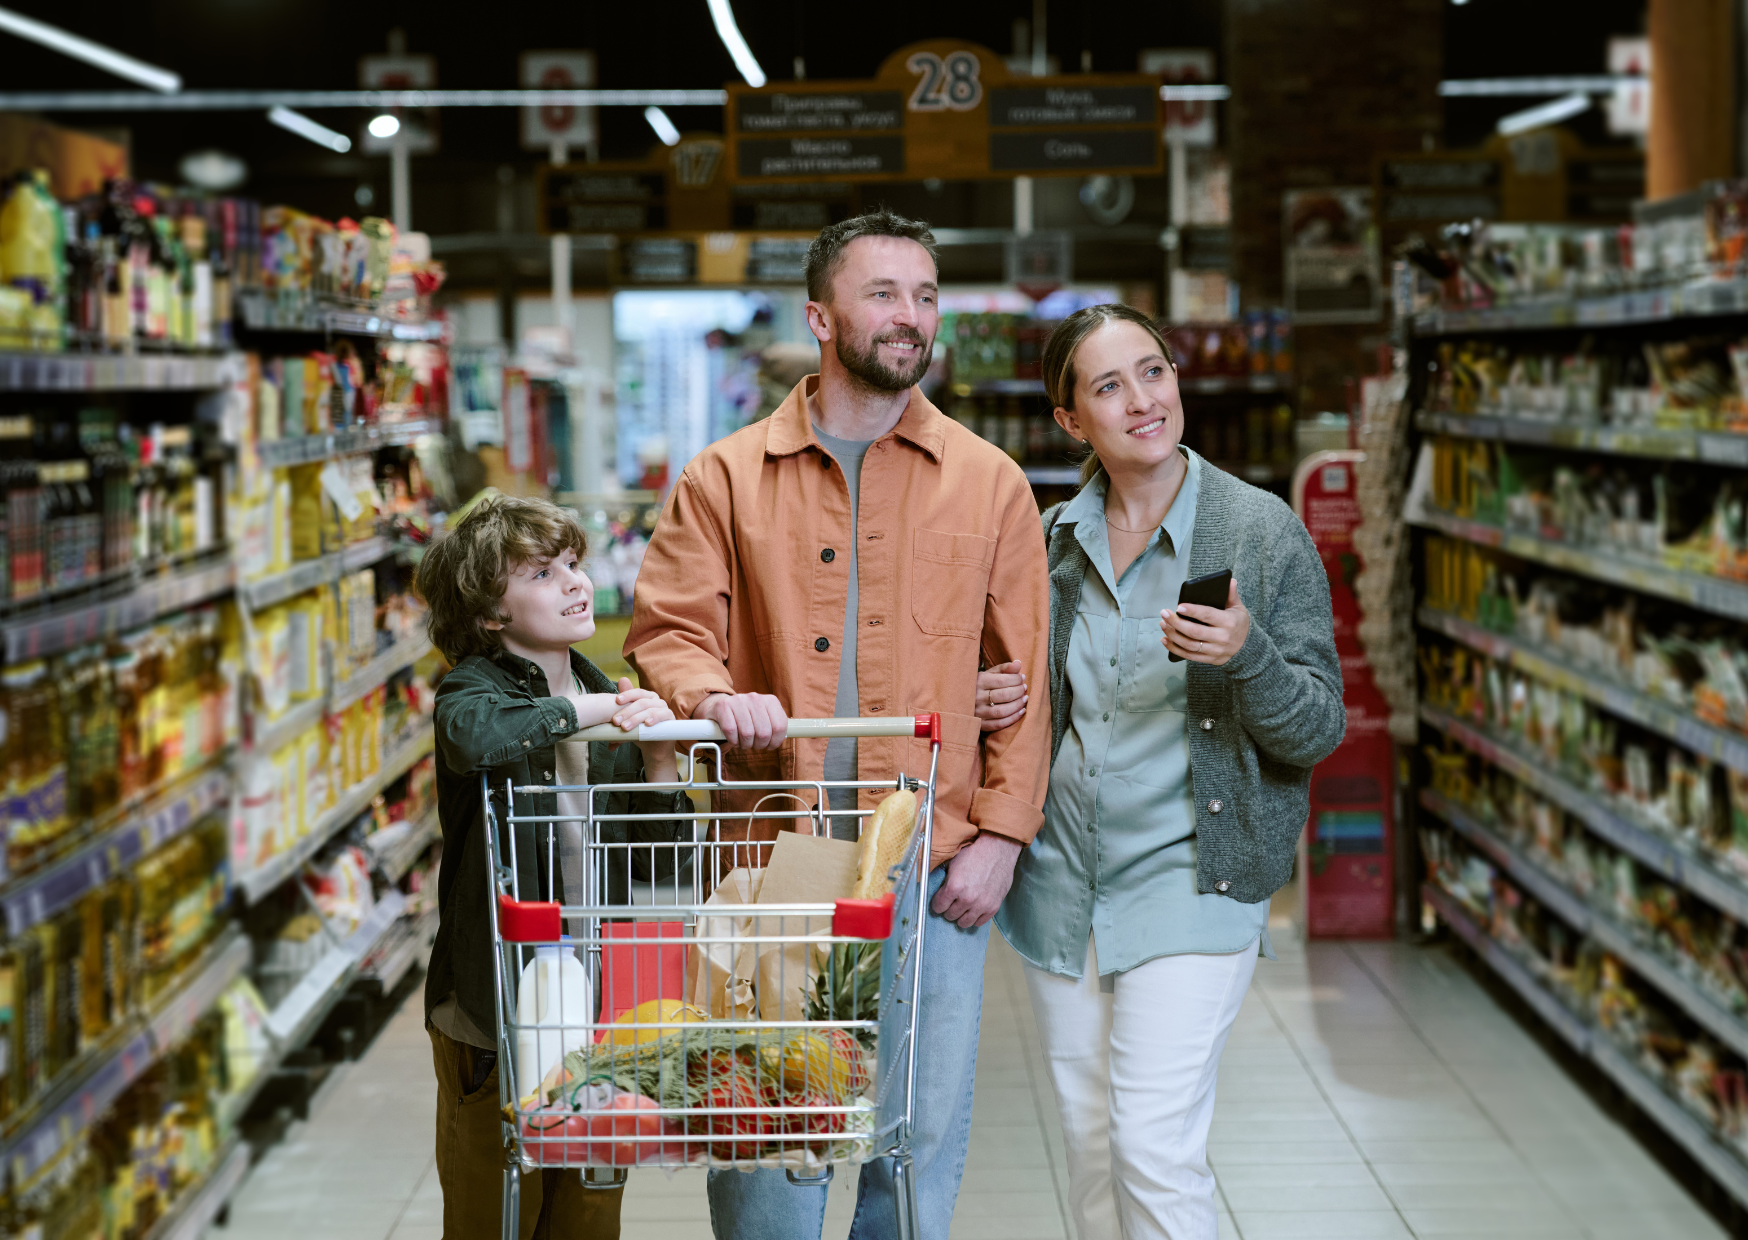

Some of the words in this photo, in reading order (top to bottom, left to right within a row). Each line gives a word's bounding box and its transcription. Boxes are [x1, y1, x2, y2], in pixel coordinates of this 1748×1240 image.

[906, 51, 983, 112] 28
[791, 138, 852, 157] Масло
[1044, 139, 1091, 159] Соль
